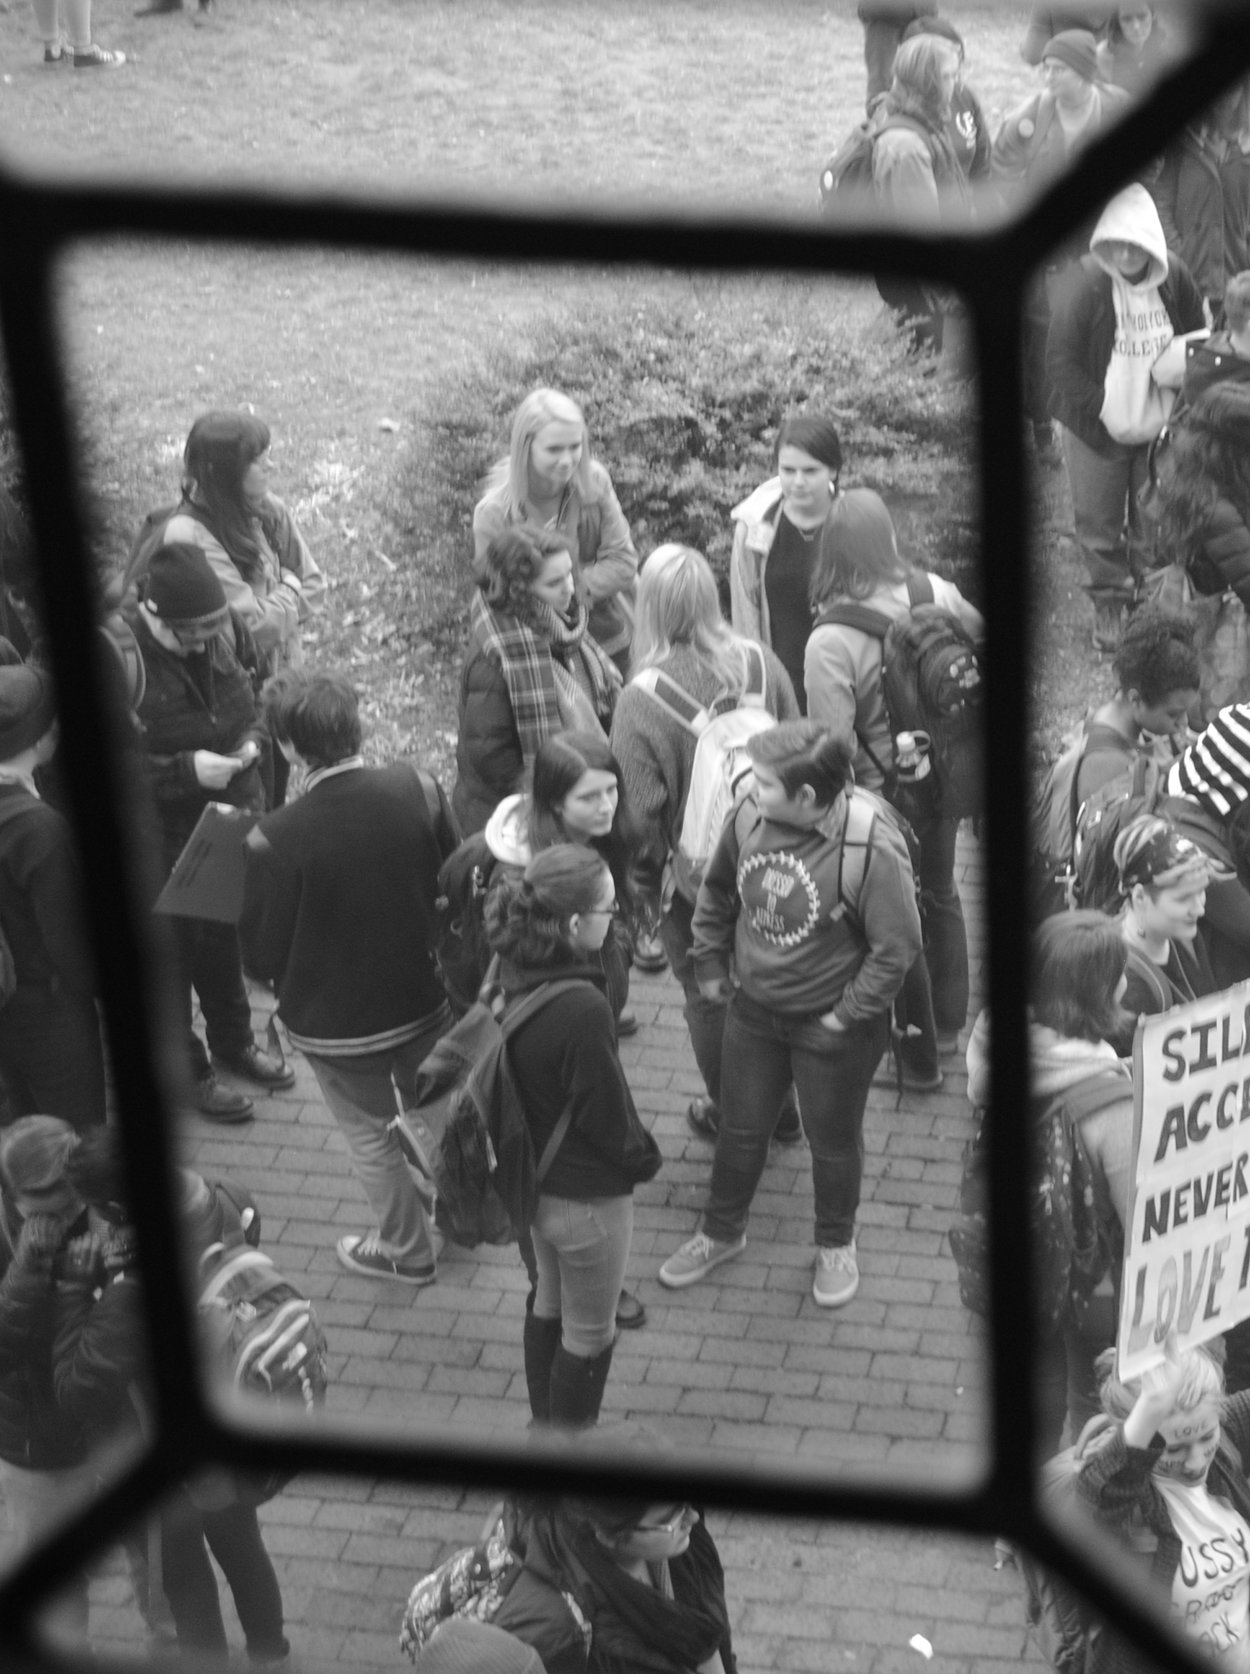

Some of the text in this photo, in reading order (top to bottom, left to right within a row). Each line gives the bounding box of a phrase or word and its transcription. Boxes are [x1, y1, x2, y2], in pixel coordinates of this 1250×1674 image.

[1141, 1151, 1249, 1244] NEVER
[1127, 1236, 1231, 1357] LOVE
[1179, 1527, 1250, 1588] USSY
[1200, 1610, 1242, 1660] ACK
